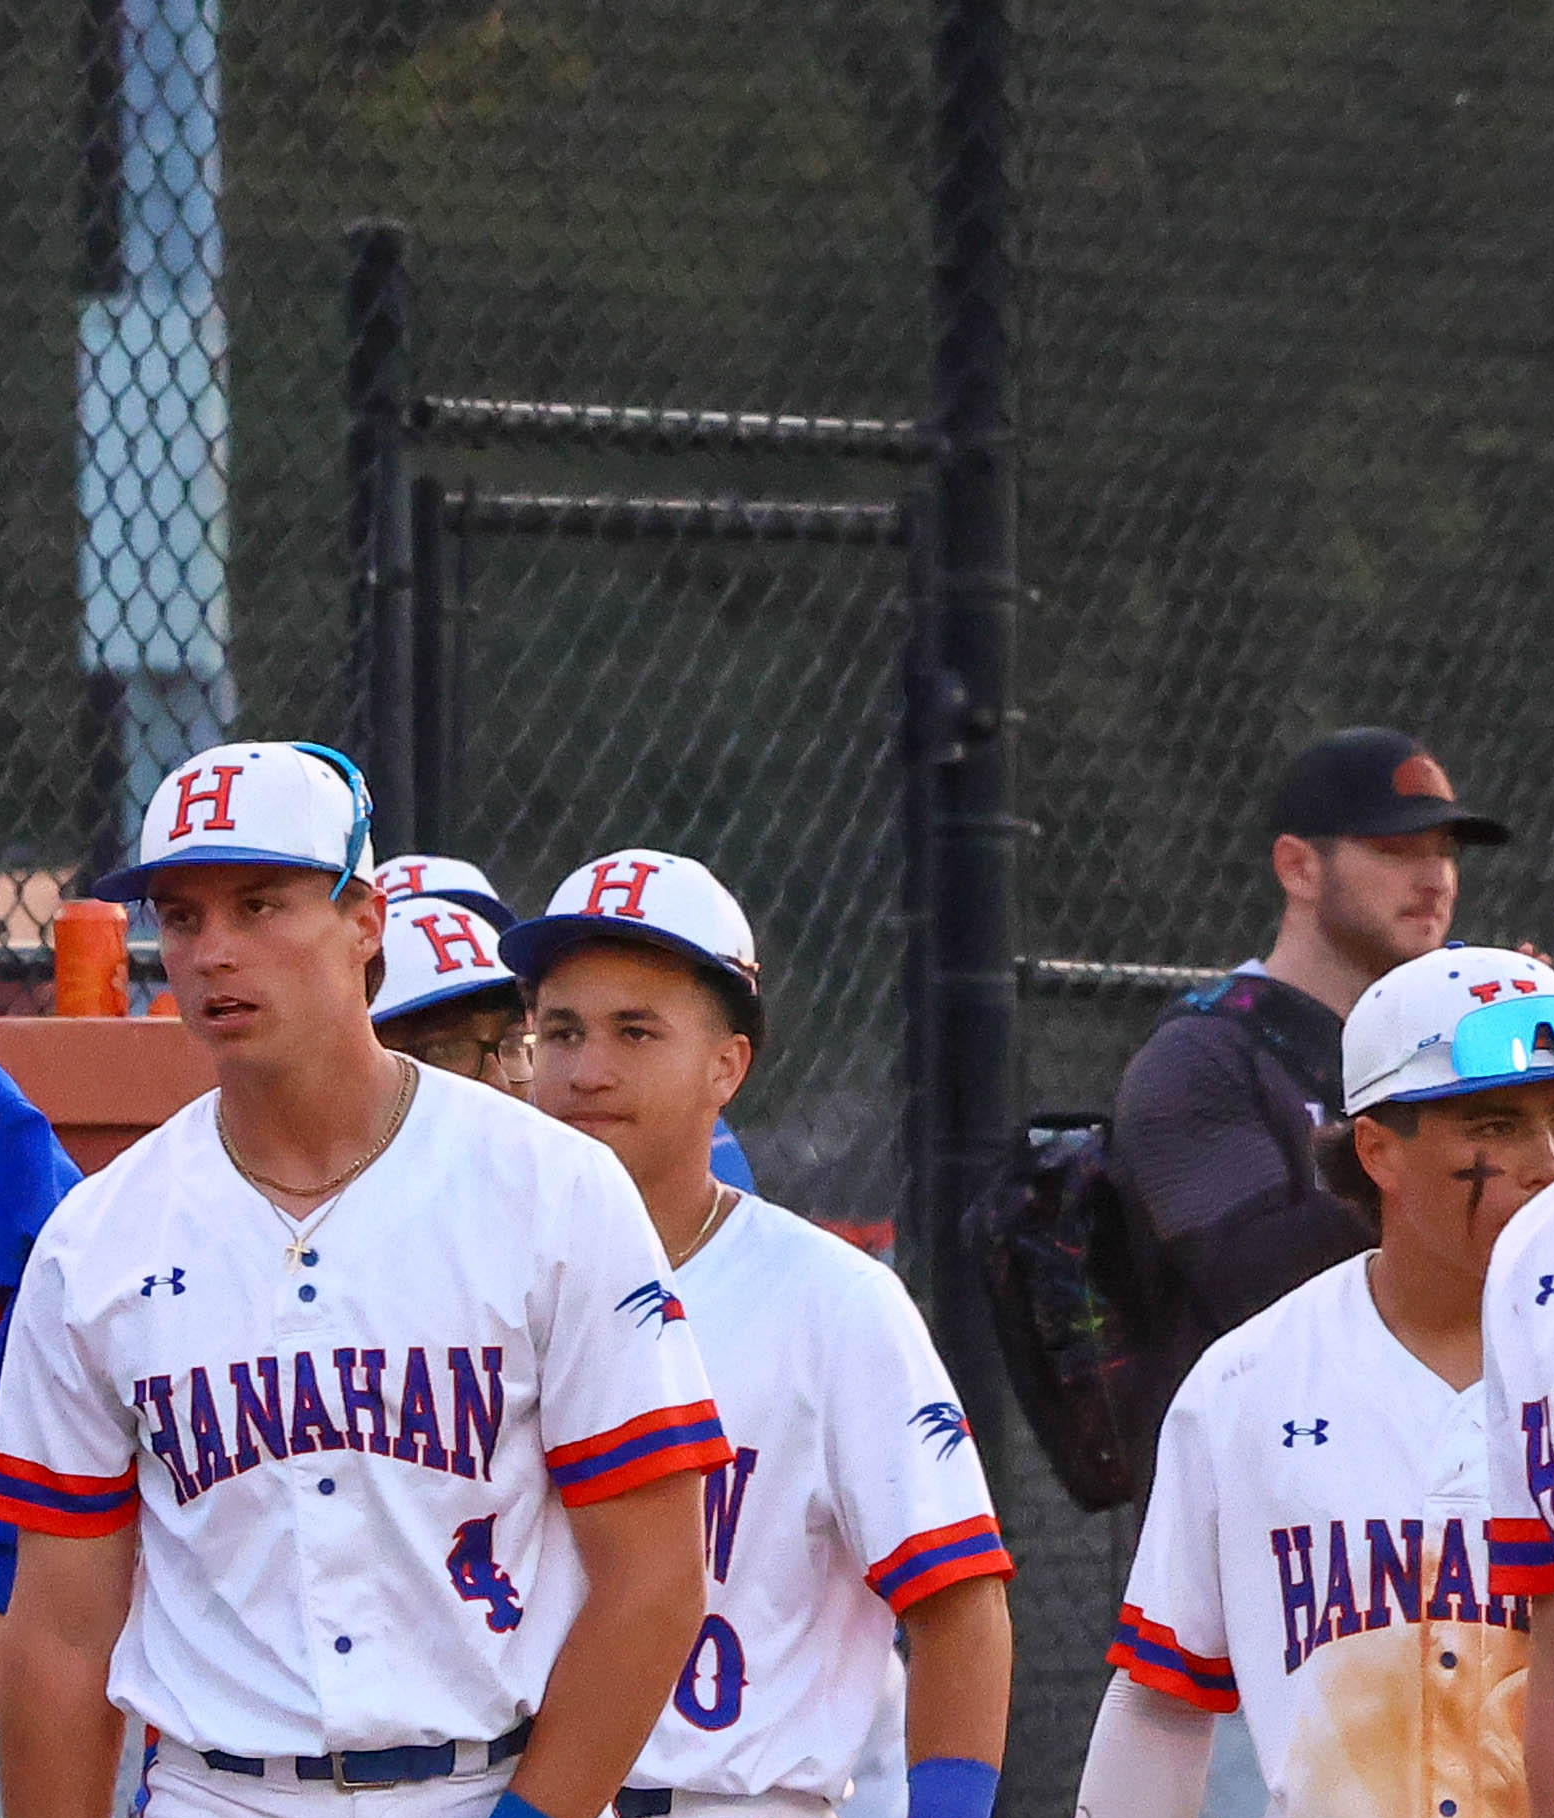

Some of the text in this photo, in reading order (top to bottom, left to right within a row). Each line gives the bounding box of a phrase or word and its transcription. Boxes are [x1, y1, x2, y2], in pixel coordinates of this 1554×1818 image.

[167, 765, 243, 839] H
[580, 860, 659, 918] H
[412, 911, 495, 975] H
[134, 1346, 505, 1506] HANAHAN
[447, 1515, 523, 1633] 4
